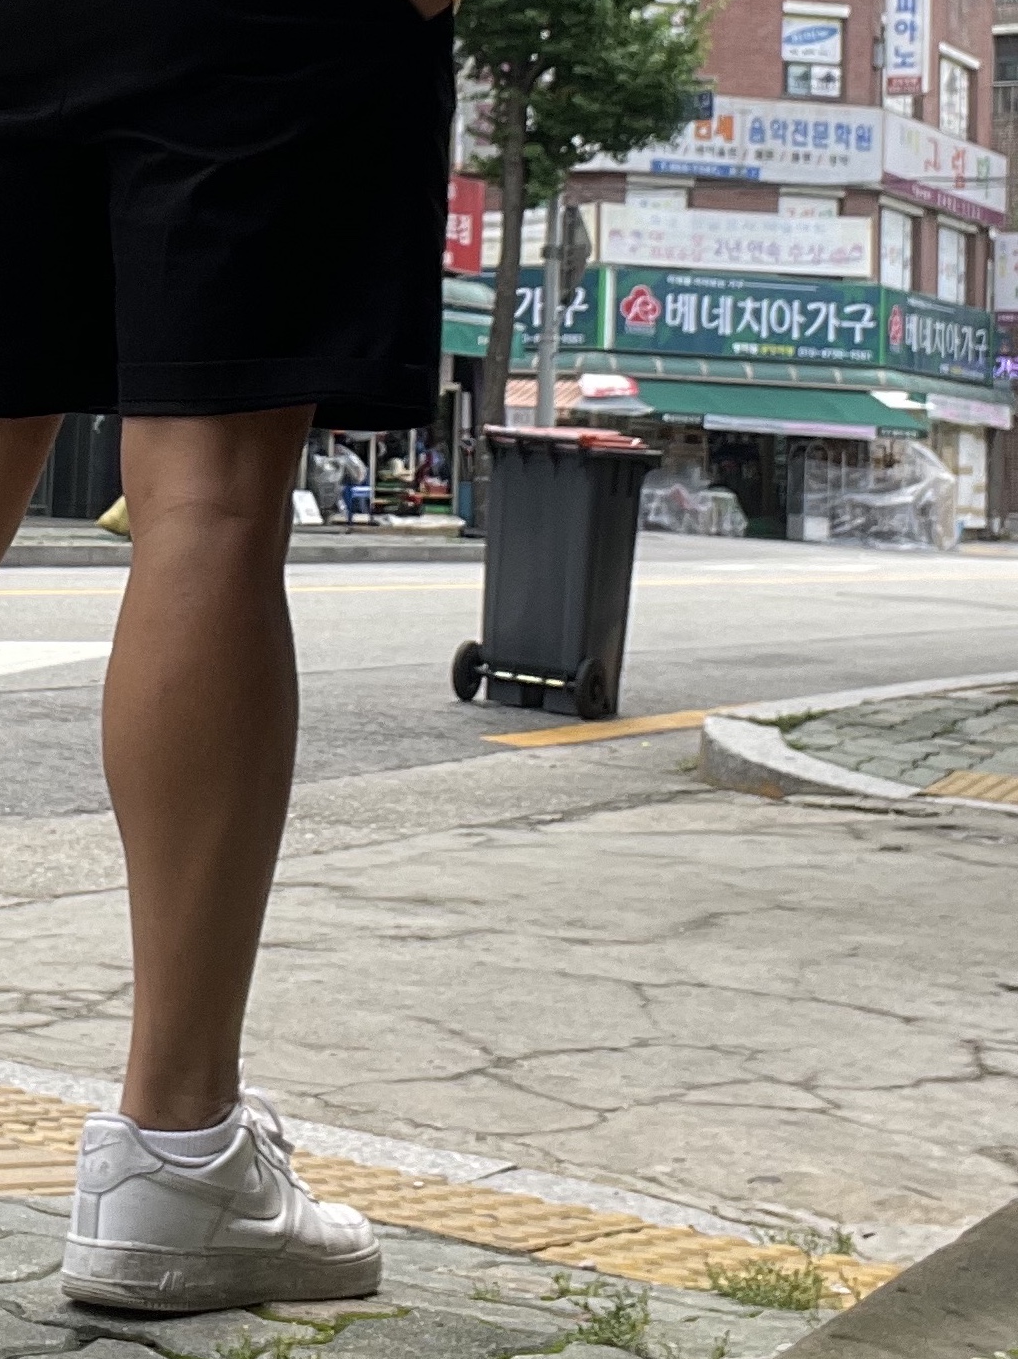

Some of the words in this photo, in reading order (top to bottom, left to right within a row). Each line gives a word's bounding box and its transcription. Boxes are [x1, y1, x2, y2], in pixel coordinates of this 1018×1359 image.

[748, 115, 874, 152] 음악전문학원
[665, 292, 877, 344] 베네치아가구
[905, 313, 989, 364] 베네치아가구
